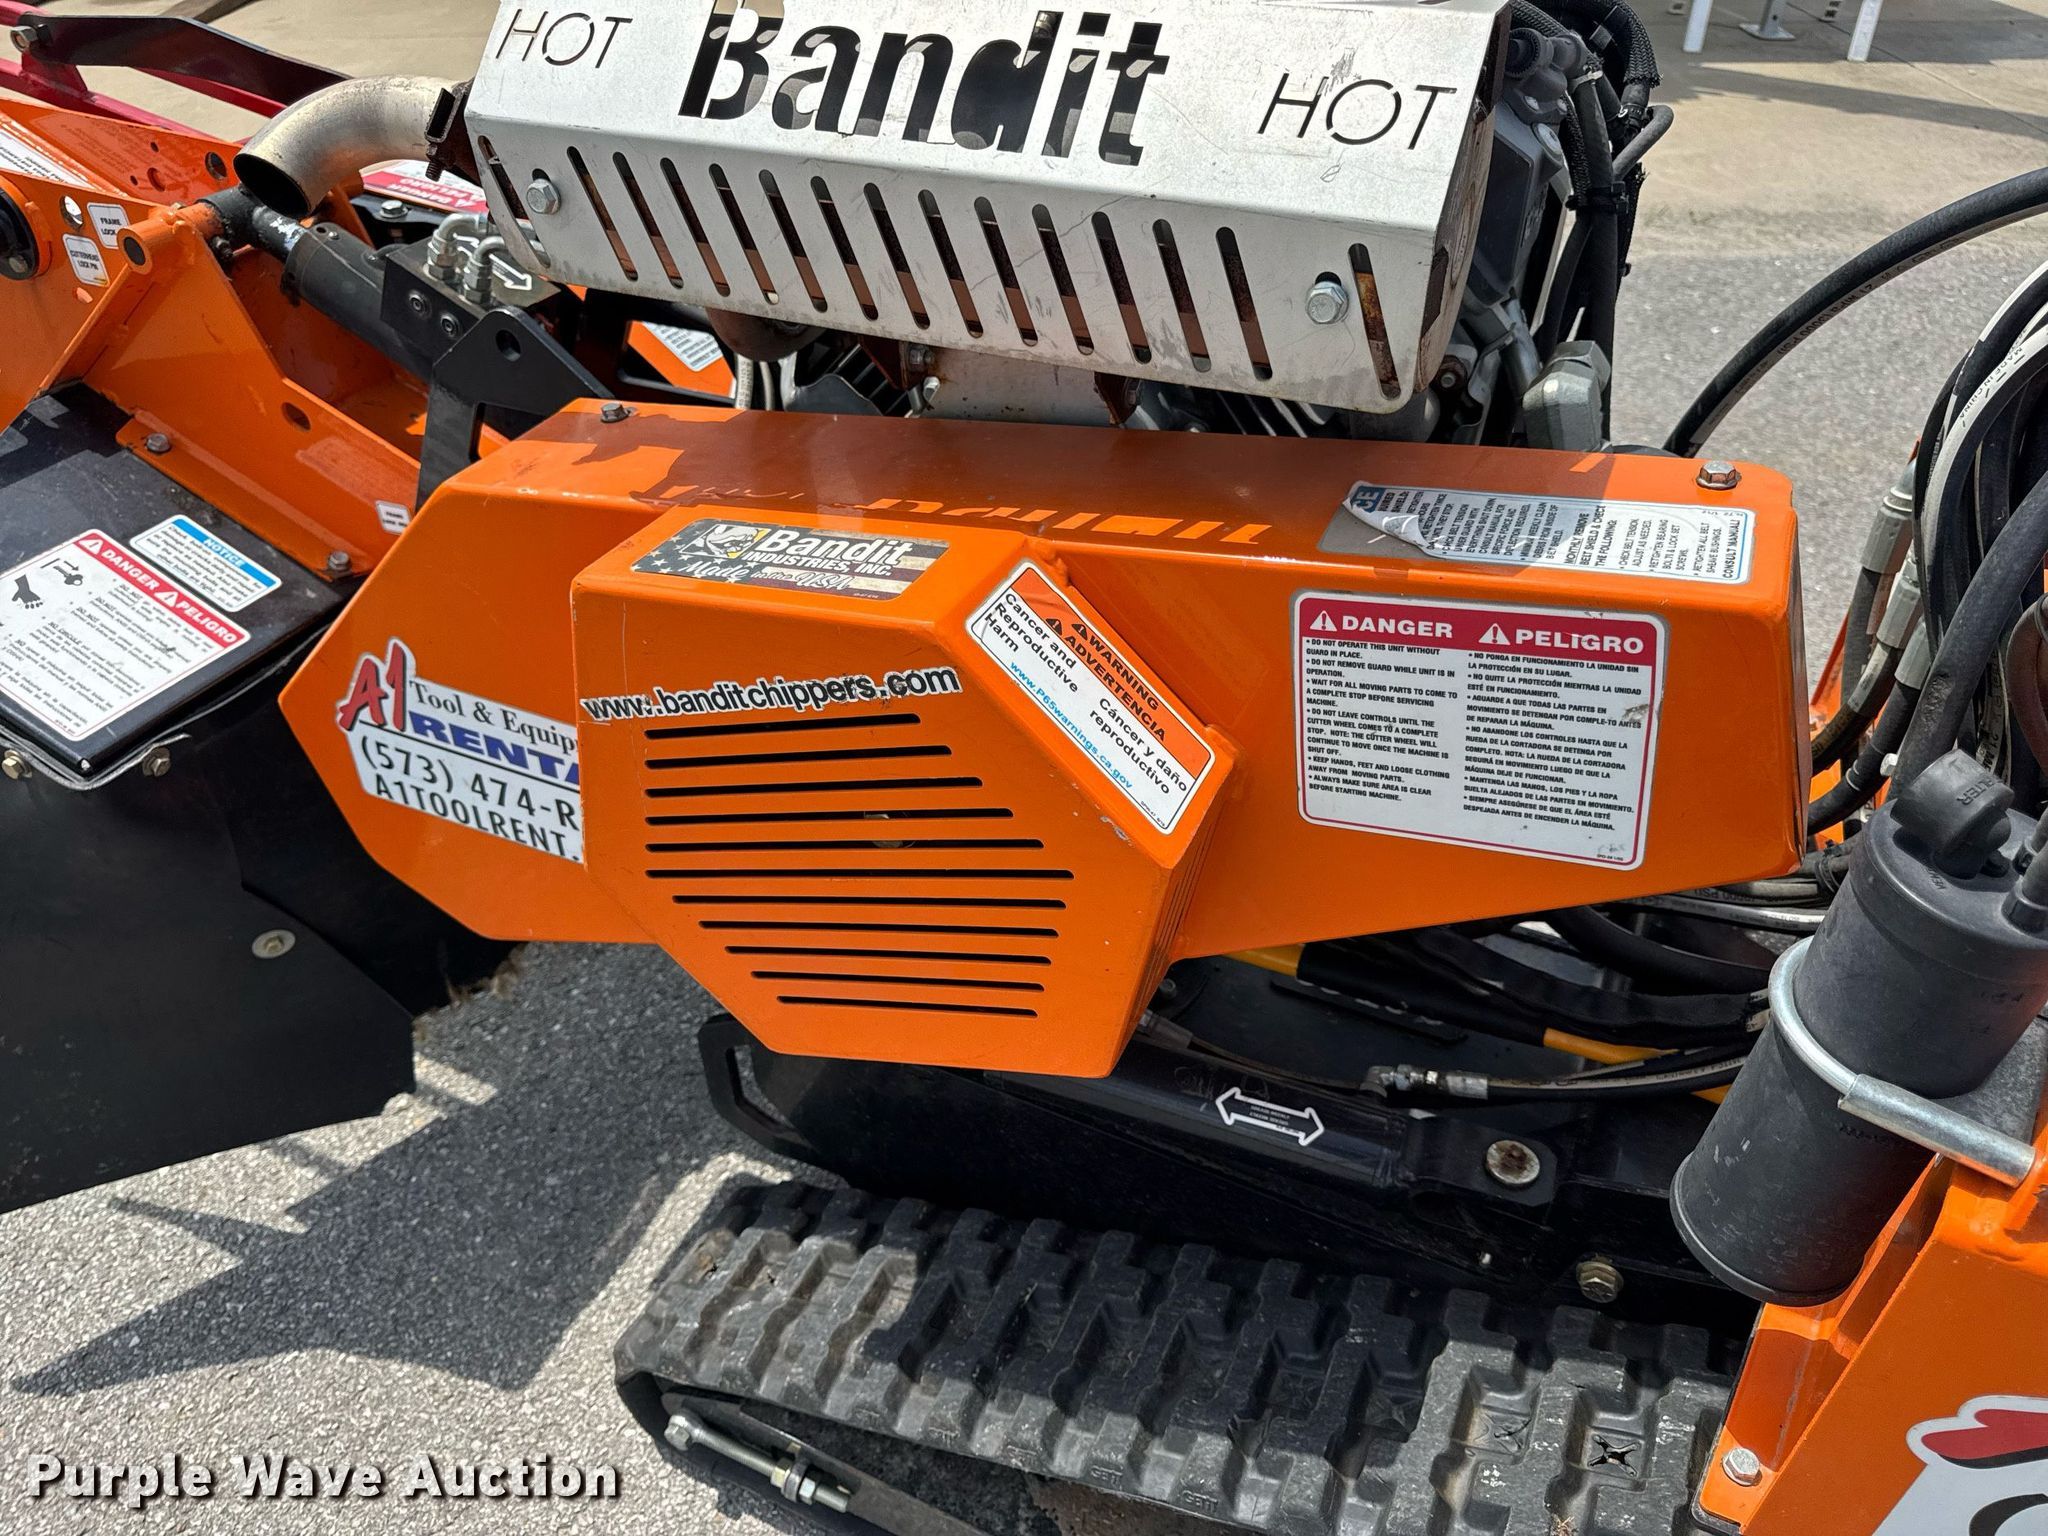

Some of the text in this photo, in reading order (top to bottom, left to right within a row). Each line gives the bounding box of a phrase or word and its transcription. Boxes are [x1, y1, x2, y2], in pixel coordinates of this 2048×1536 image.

[496, 0, 1458, 166] HOT Bandit HOT
[202, 536, 246, 570] NOTICE
[742, 551, 893, 577] INDUSTRIES, INC.
[759, 528, 914, 565] Bandit
[683, 560, 751, 581] Made
[100, 547, 157, 591] DANGER
[175, 599, 238, 646] PELIGRO
[984, 612, 1019, 652] Harm
[994, 602, 1079, 693] Reproductive
[1005, 593, 1077, 669] Cancer and
[1337, 641, 1367, 649] OPERATE
[1406, 646, 1439, 655] WITHOUT
[1342, 614, 1645, 655] DANGER PELIGRO
[1089, 635, 1159, 711] WARNING
[1336, 661, 1365, 669] REMOVE
[1367, 663, 1391, 671] GUARD
[338, 642, 406, 731] A1
[583, 668, 961, 720] www.banditchippers.com
[1064, 635, 1166, 742] ADVERTENCIA
[1311, 678, 1327, 686] WAIT
[1358, 683, 1387, 691] MOVING
[1388, 686, 1411, 694] PARTS
[1424, 689, 1446, 697] COME
[1312, 688, 1346, 697] COMPLETE
[1367, 694, 1394, 702] BEFORE
[1396, 697, 1434, 706] SERVICING
[409, 679, 579, 755] Tool & Equip
[1010, 661, 1134, 789] www.P65warnings.ca.gov
[1306, 717, 1331, 725] CUTTER
[1333, 720, 1355, 728] WHEEL
[1357, 722, 1382, 731] COMES
[1401, 727, 1438, 737] COMPLETE
[1360, 713, 1396, 722] CONTROLS
[1398, 717, 1418, 725] UNTIL
[1089, 709, 1170, 795] reproductivo
[1099, 698, 1188, 792] Cáncer y daño
[1307, 736, 1340, 745] CONTINUE
[1351, 741, 1371, 749] MOVE
[1407, 748, 1439, 757] MACHINE
[1307, 745, 1324, 753] SHUT
[1365, 733, 1392, 742] CUTTER
[1393, 736, 1417, 745] WHEEL
[1419, 739, 1436, 747] WILL
[361, 736, 453, 793] (573)
[1308, 764, 1327, 772] AWAY
[1328, 767, 1348, 775] FROM
[1351, 770, 1378, 778] MOVING
[1357, 761, 1373, 769] FEET
[1374, 763, 1389, 771] AND
[1390, 765, 1413, 774] LOOSE
[1414, 768, 1450, 778] CLOTHING
[1308, 783, 1333, 791] BEFORE
[1335, 786, 1367, 796] STARTING
[1313, 774, 1340, 783] ALWAYS
[1341, 778, 1360, 786] MAKE
[1361, 780, 1380, 788] SURE
[1381, 783, 1399, 791] AREA
[1409, 787, 1431, 795] CLEAR
